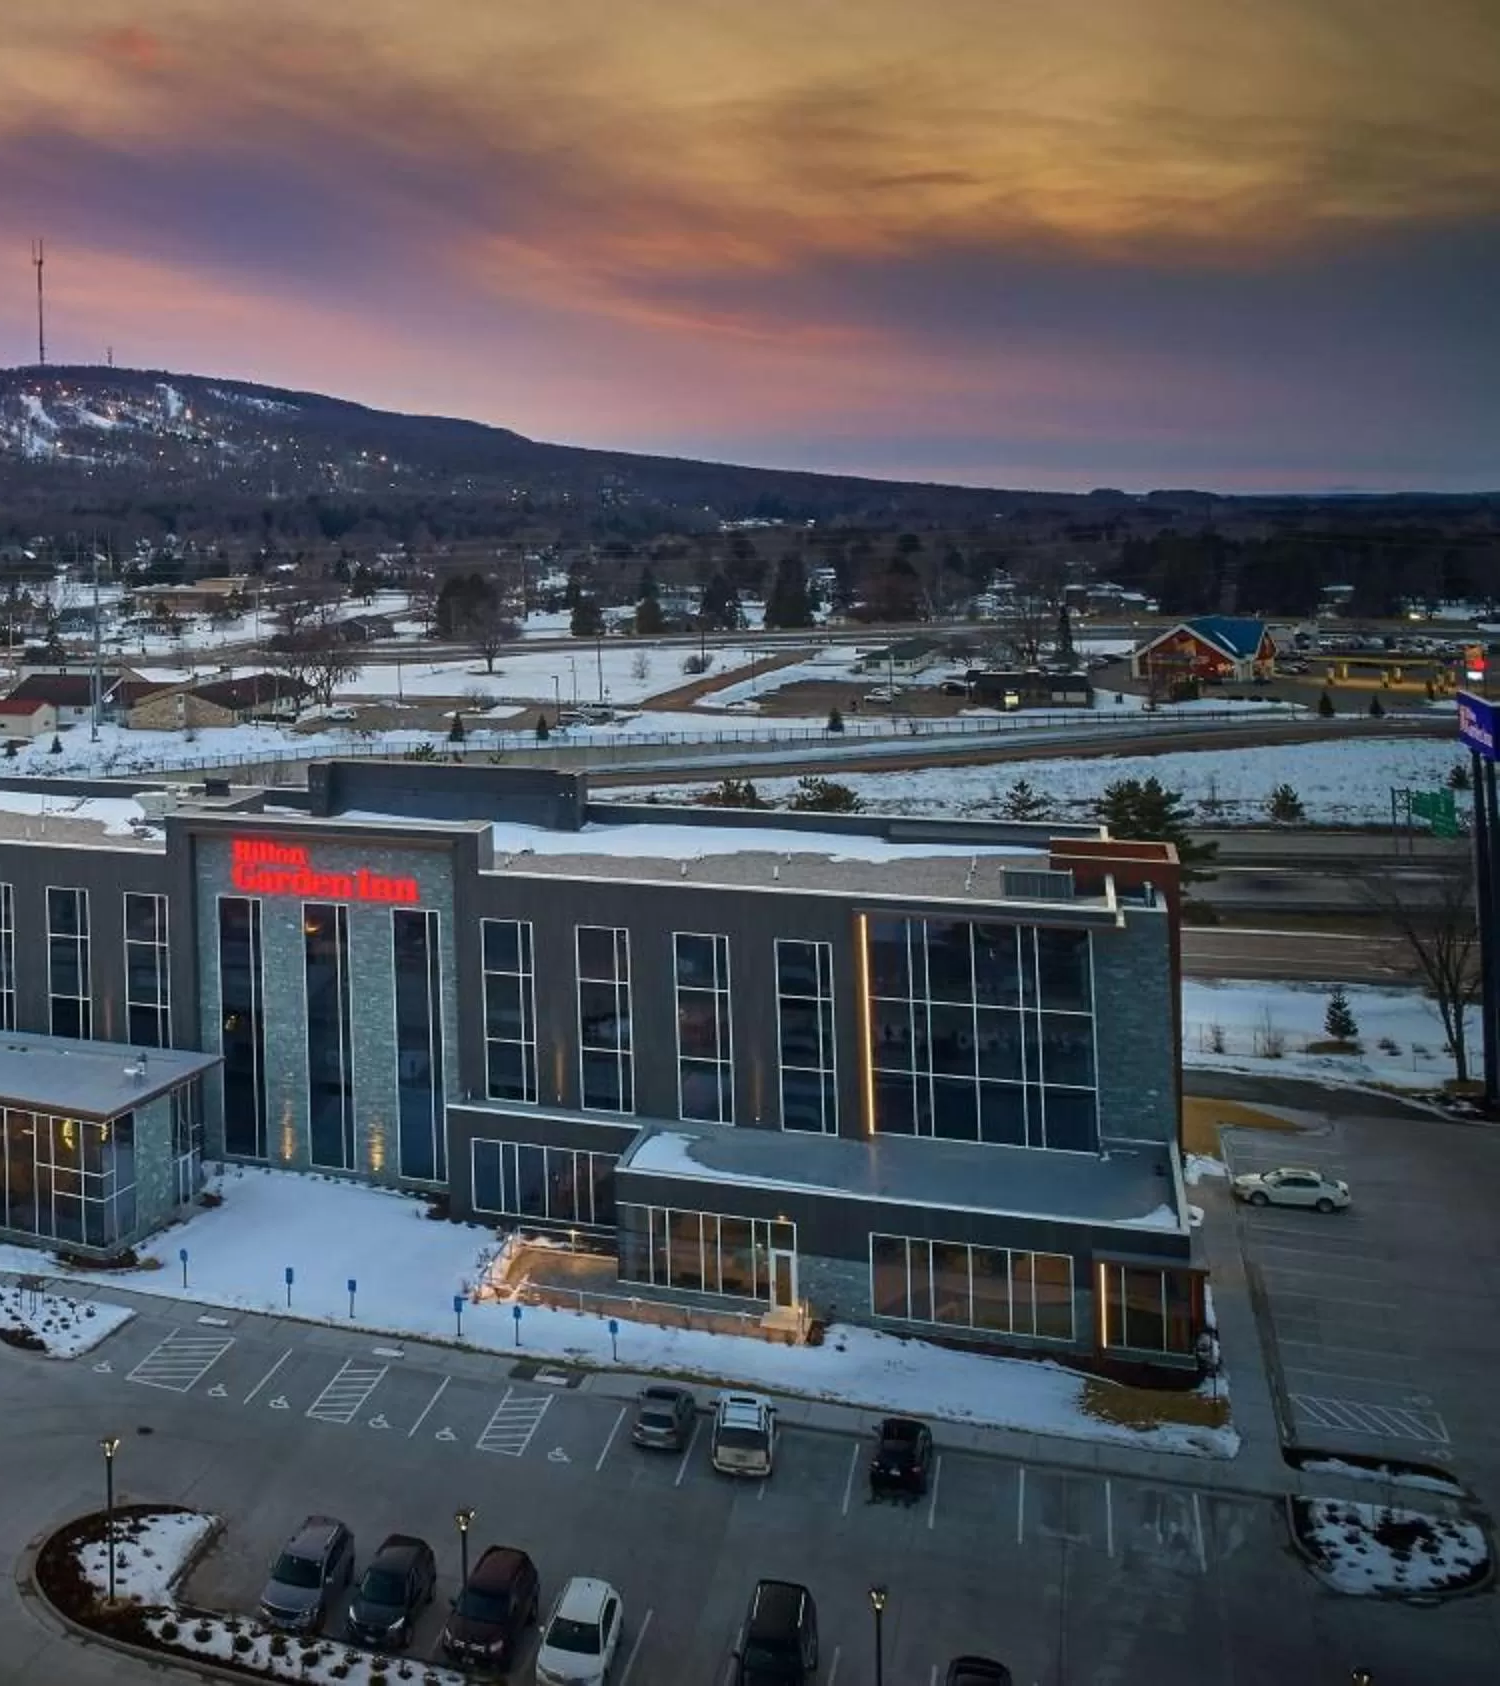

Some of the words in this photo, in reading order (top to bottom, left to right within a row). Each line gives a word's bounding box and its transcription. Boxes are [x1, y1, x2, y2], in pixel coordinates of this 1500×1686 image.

[233, 839, 306, 864] Hilton
[233, 864, 353, 897] Garden
[356, 868, 418, 902] Inn
